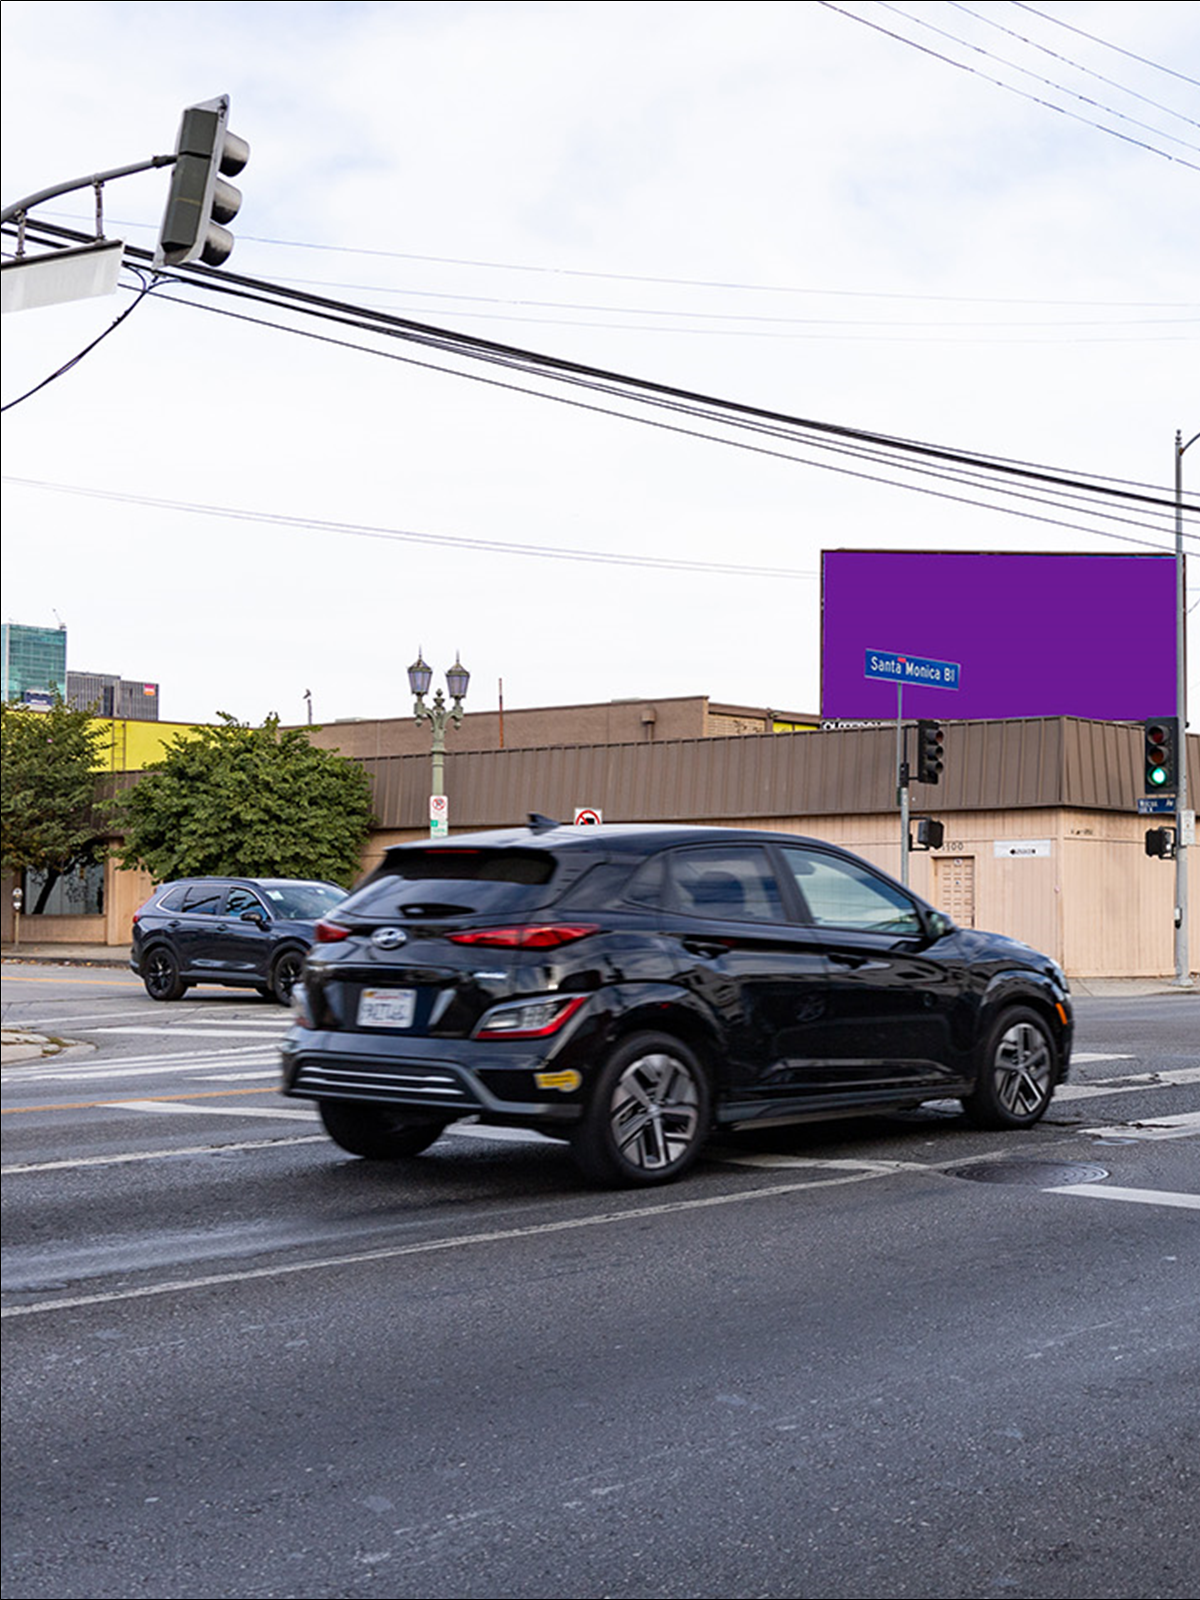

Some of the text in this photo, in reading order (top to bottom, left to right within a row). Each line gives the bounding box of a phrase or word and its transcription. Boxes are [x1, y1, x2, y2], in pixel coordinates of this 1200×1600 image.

[870, 656, 955, 682] Santa Monica Bl
